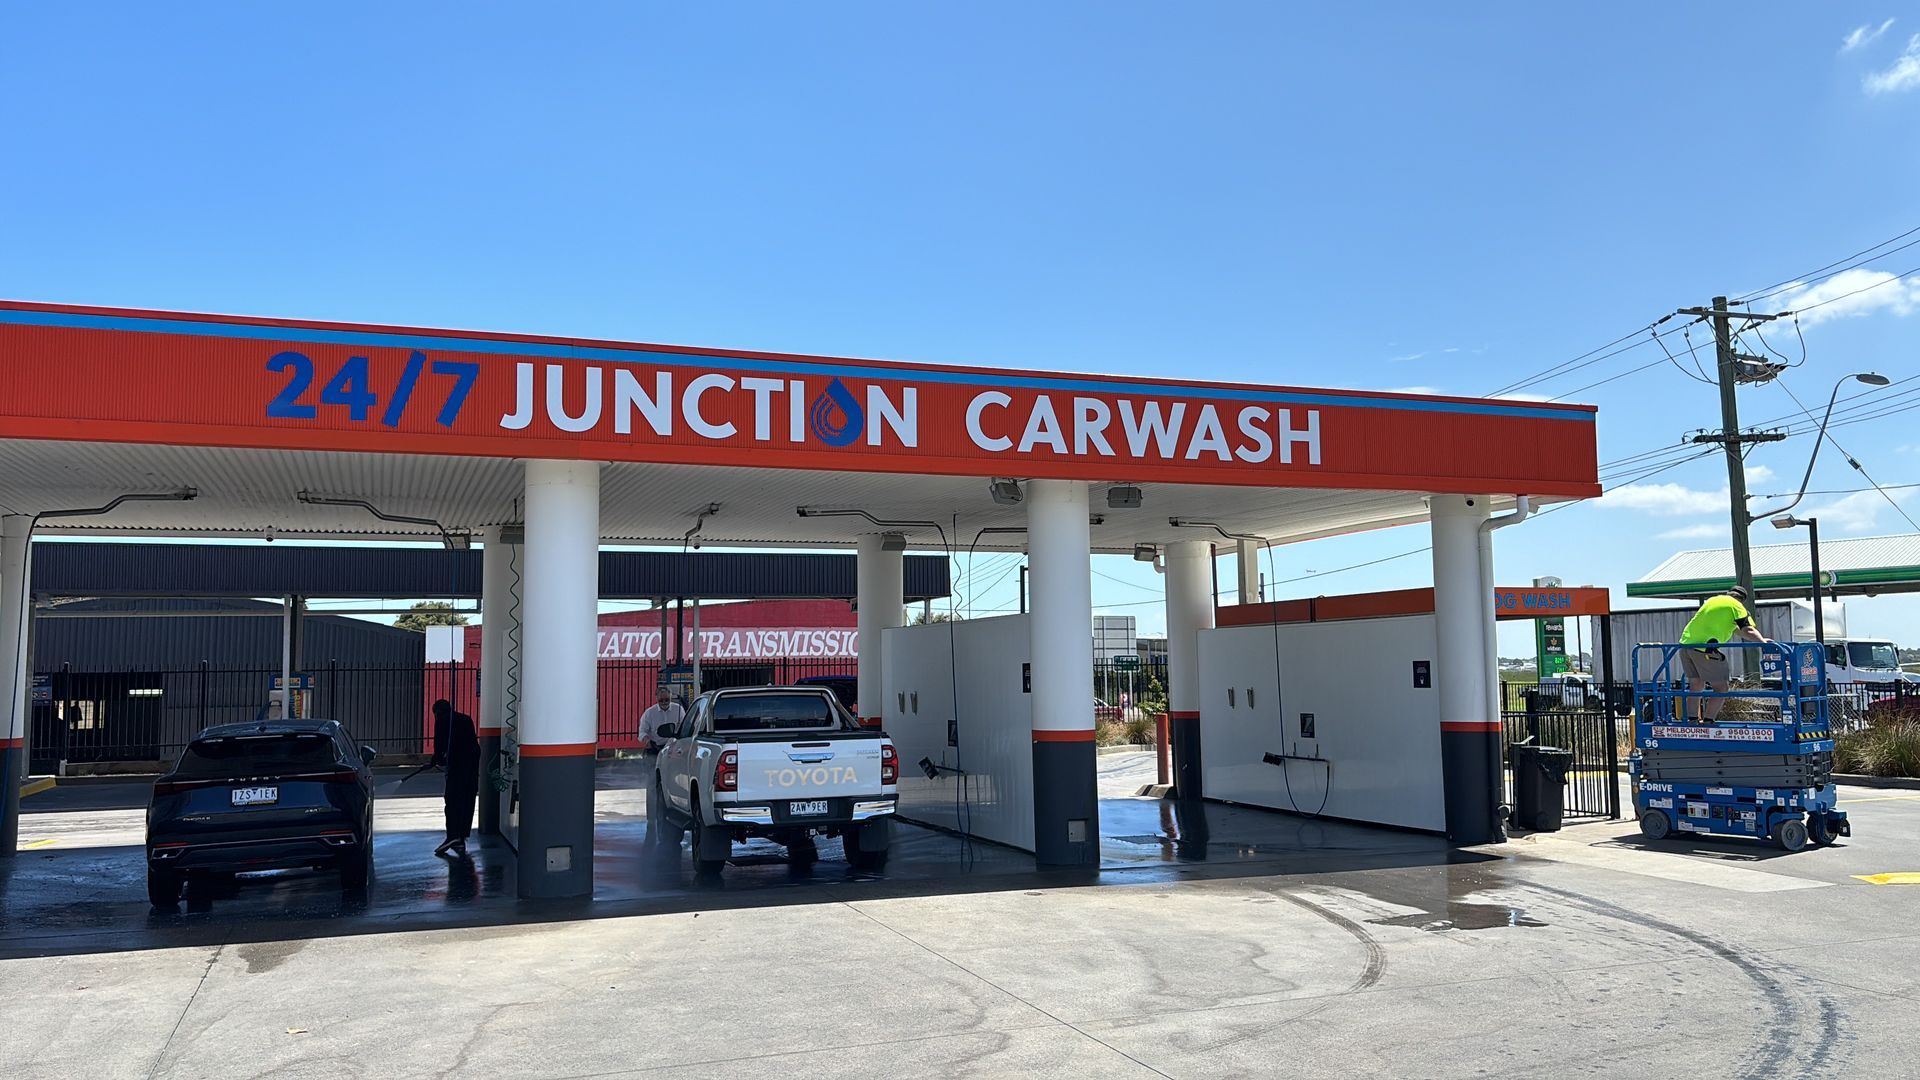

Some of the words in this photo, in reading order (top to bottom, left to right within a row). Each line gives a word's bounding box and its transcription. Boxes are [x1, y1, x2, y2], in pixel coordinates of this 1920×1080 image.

[266, 350, 480, 428] 24/7
[965, 391, 1321, 465] CARWASH
[1521, 592, 1571, 609] WASH
[1763, 662, 1776, 670] 96
[1645, 739, 1659, 748] 96
[764, 766, 858, 787] TOYOTA
[1639, 783, 1673, 793] E-DRIVE
